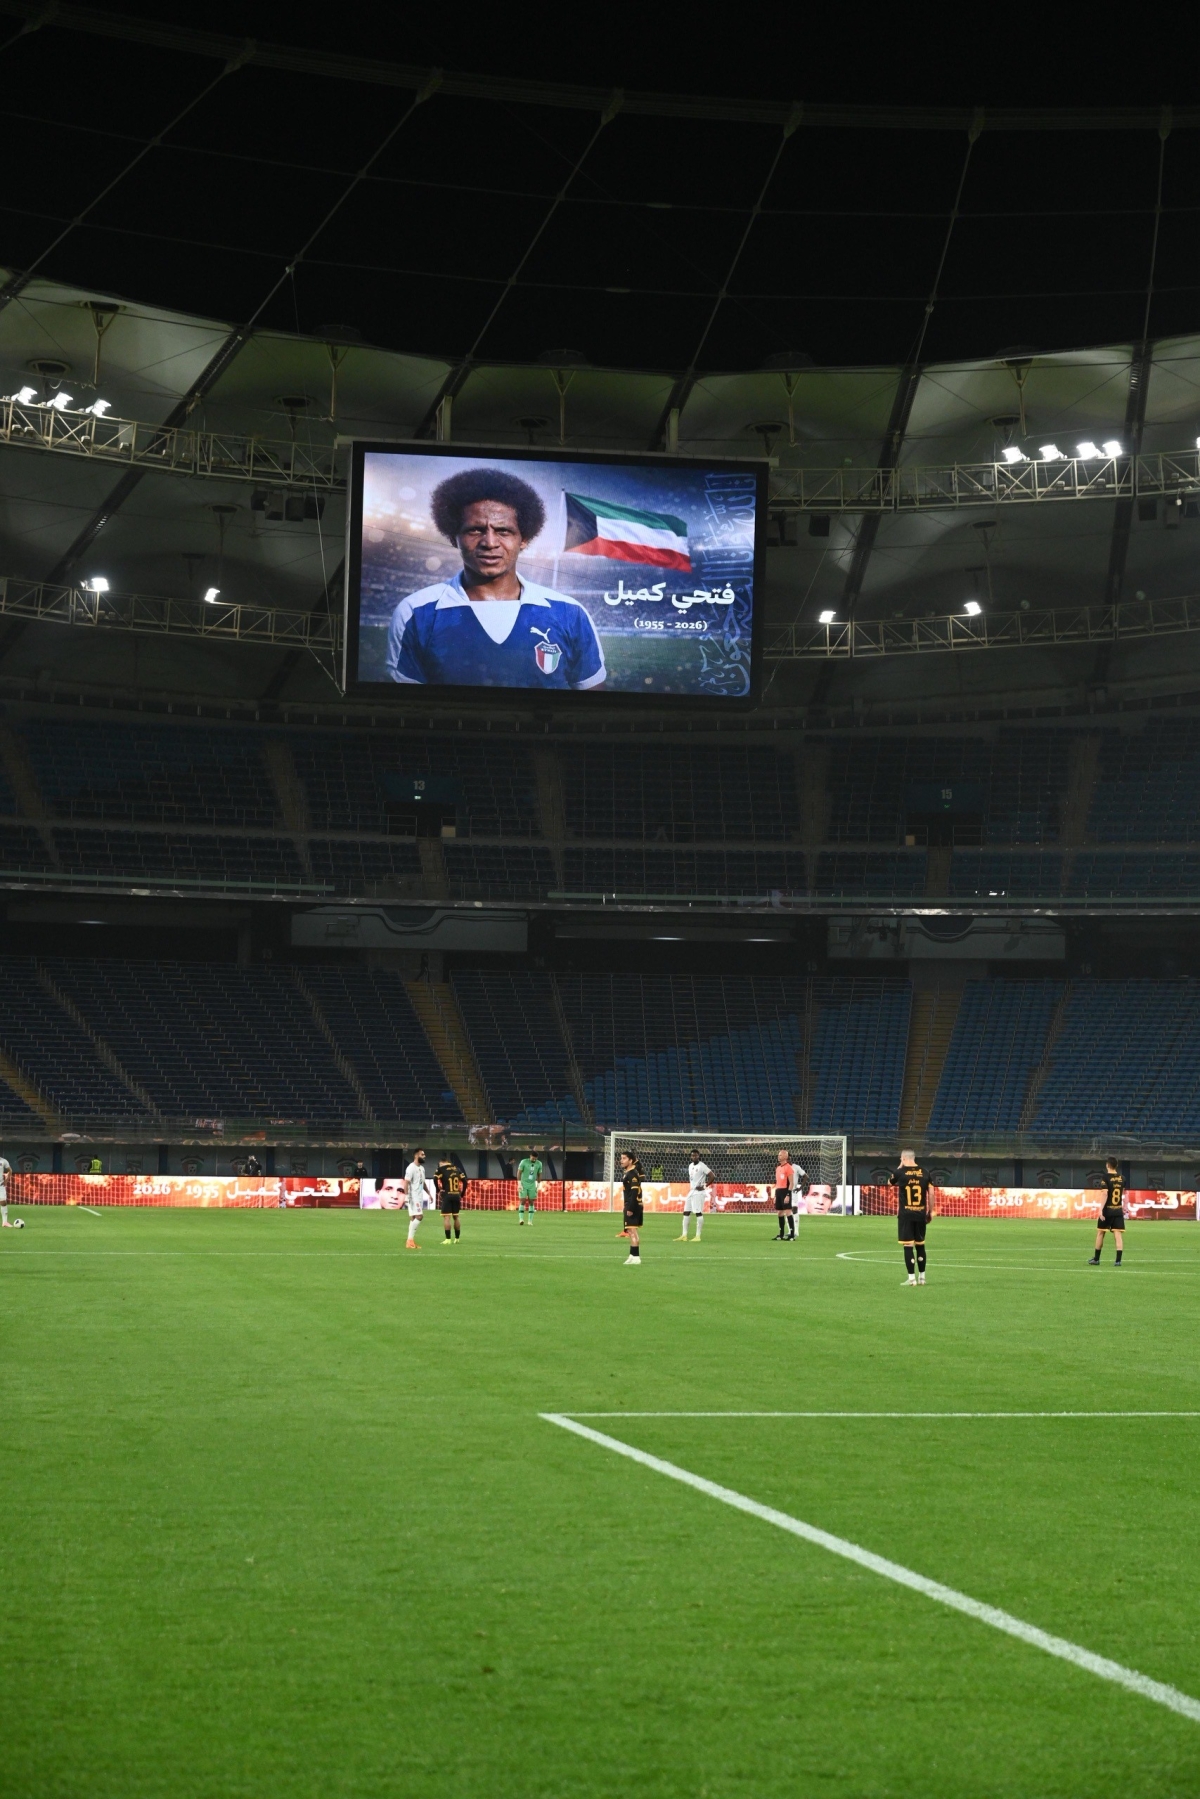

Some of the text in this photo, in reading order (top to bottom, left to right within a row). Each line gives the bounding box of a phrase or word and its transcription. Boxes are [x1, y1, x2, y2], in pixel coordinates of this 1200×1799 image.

[603, 580, 735, 614] فتحي كميل
[633, 617, 664, 630] (1955
[674, 619, 708, 631] 2026)
[413, 780, 425, 791] 13
[941, 788, 953, 800] 15
[132, 1182, 171, 1195] 2026
[226, 1181, 282, 1200] كميل
[448, 1176, 459, 1192] 18
[185, 1184, 219, 1199] 1955
[569, 1189, 606, 1201] 2026
[904, 1185, 922, 1206] 13
[1111, 1188, 1121, 1206] 8
[988, 1195, 1023, 1207] 2026
[1036, 1196, 1068, 1210] 1955
